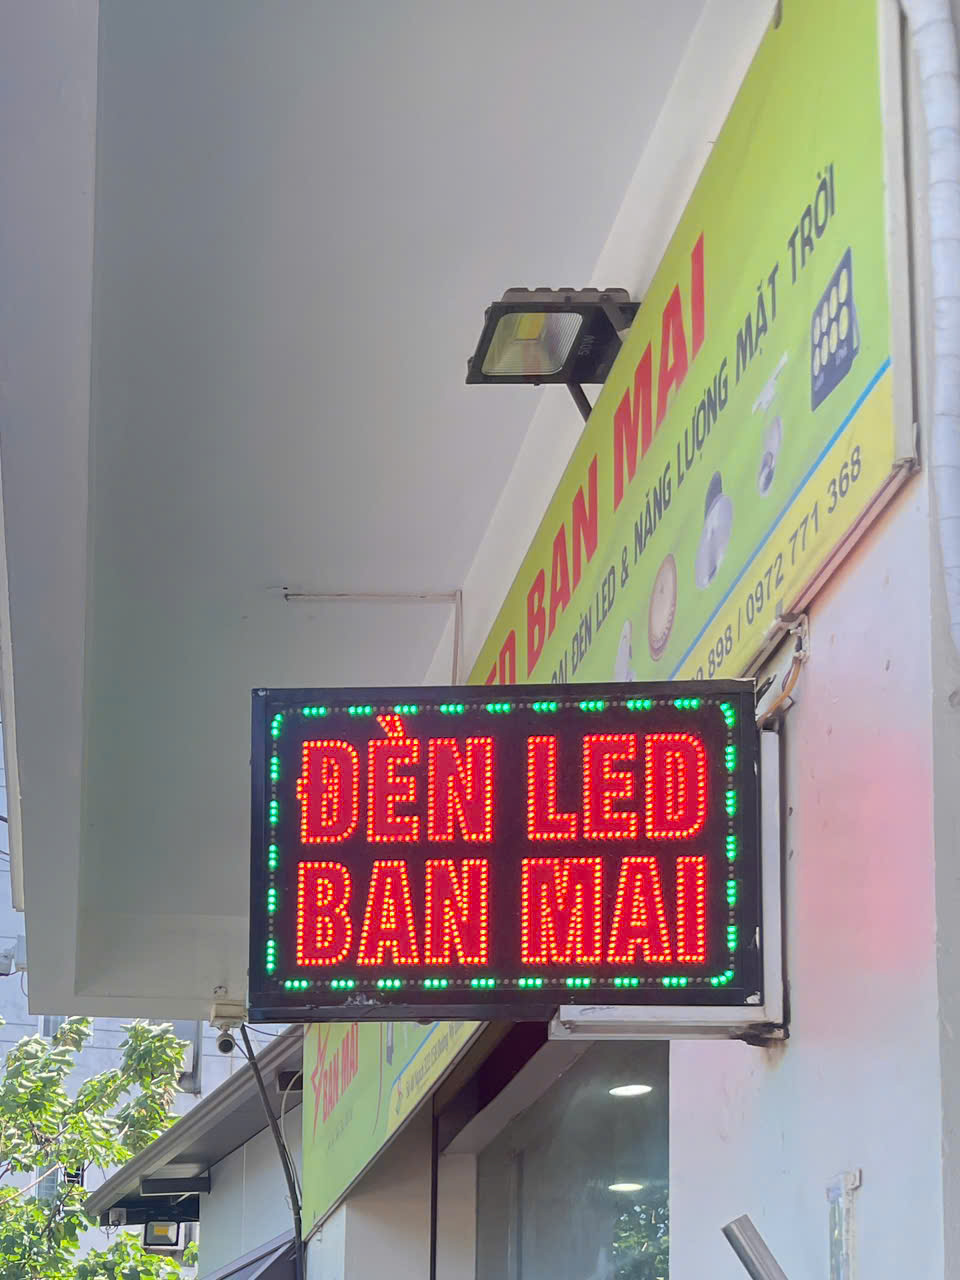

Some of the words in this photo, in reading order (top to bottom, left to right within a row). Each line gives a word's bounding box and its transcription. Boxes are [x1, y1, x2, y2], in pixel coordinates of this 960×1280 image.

[527, 452, 597, 680] BAN
[613, 230, 704, 513] MAI
[596, 565, 615, 632] LED
[620, 546, 629, 588] &
[708, 625, 733, 678] 898
[746, 552, 784, 625] 0972
[789, 501, 819, 566] 771
[828, 445, 861, 514] 368
[295, 713, 495, 844] ĐÈN
[526, 732, 709, 841] LED
[295, 857, 489, 966] BAN
[521, 855, 707, 965] MAI
